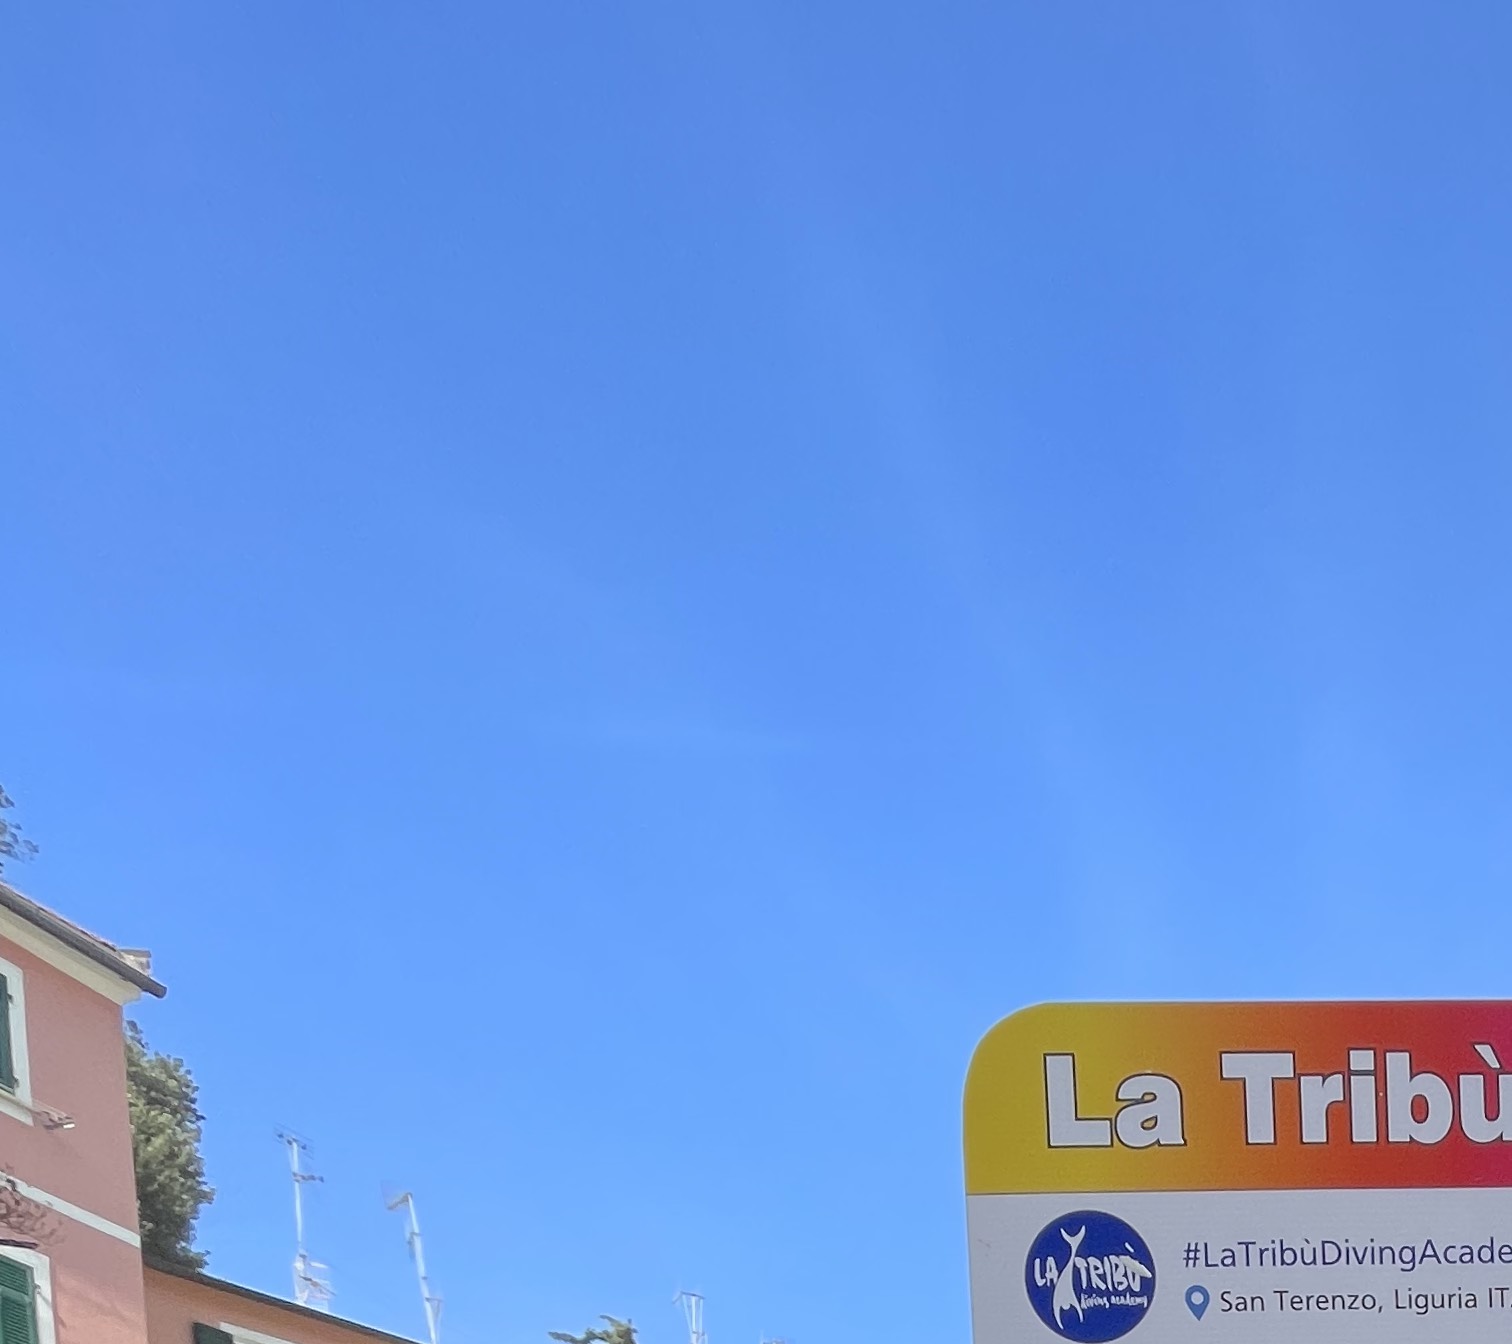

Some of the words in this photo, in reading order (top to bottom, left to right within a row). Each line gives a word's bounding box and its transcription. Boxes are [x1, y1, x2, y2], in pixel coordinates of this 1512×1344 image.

[1043, 1053, 1187, 1148] La
[1034, 1256, 1059, 1287] LA
[1220, 1290, 1265, 1312] San
[1273, 1289, 1383, 1314] Terenzo,
[1394, 1287, 1478, 1315] Liguria
